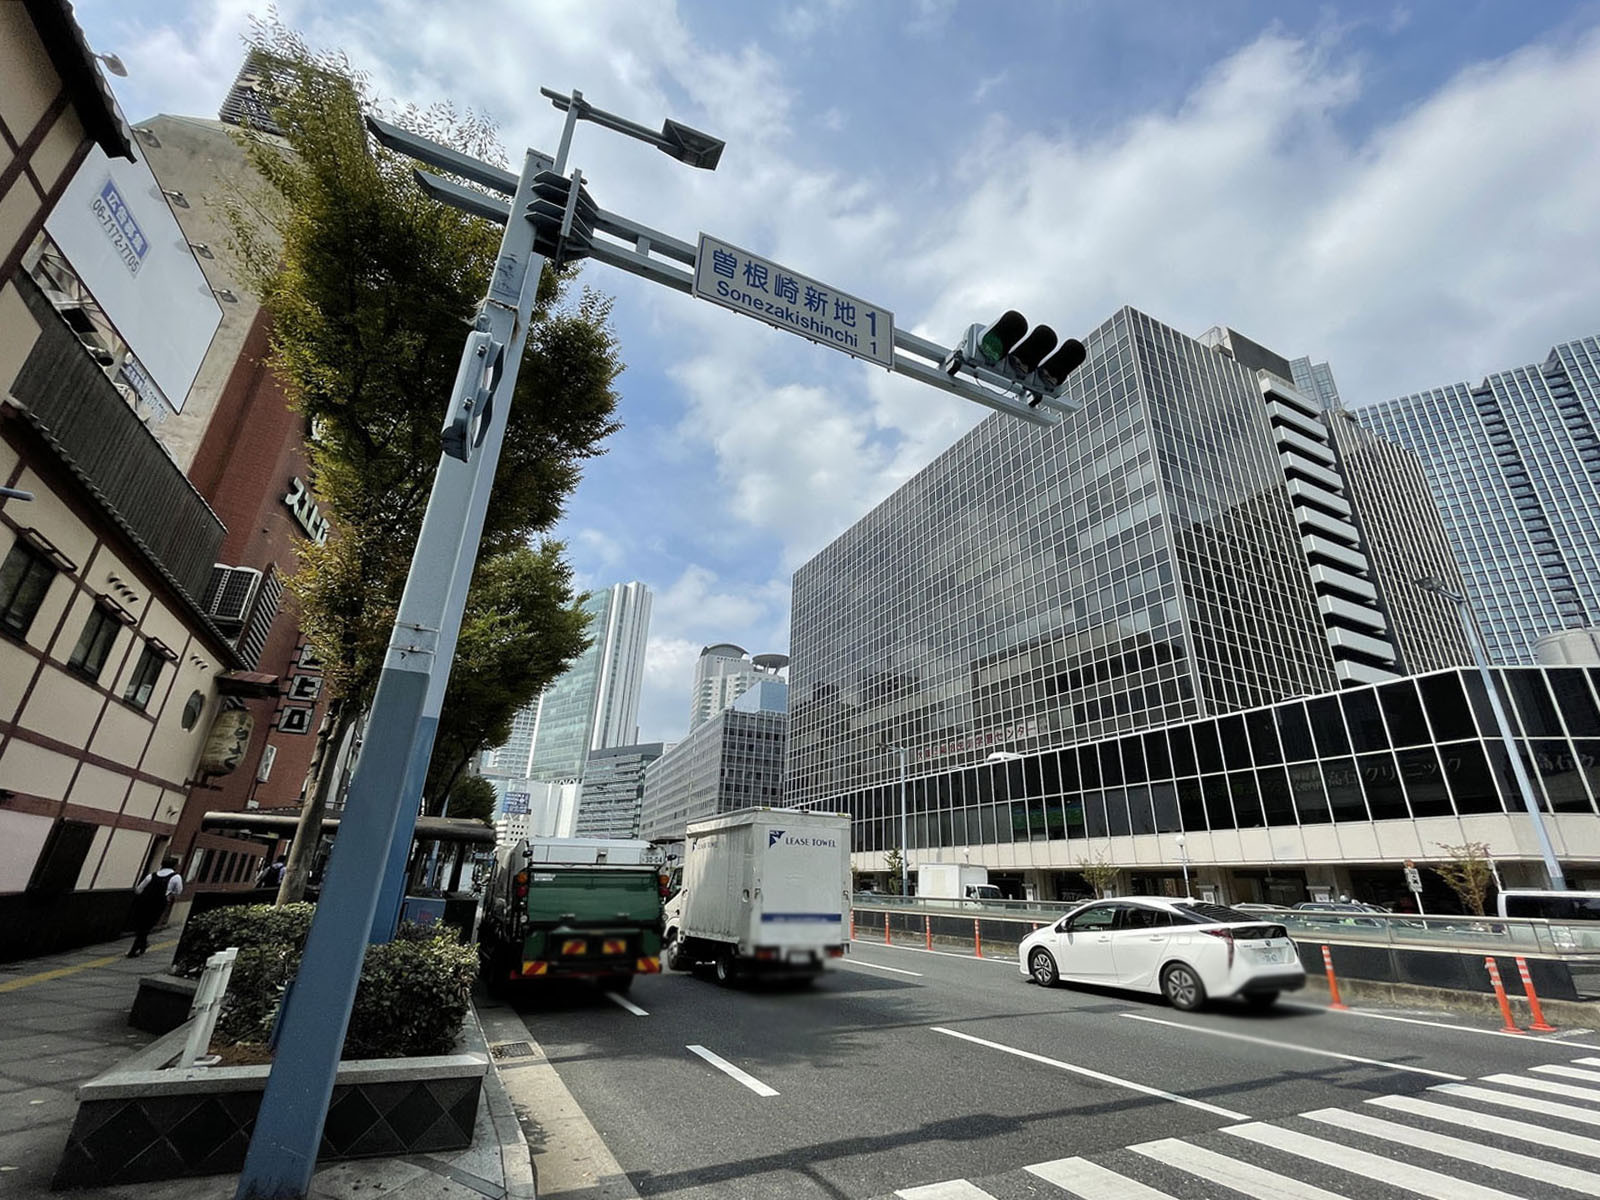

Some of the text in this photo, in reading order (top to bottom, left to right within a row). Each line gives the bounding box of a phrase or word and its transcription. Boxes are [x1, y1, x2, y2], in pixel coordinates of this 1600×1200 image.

[93, 199, 139, 272] 06-7172-7705
[717, 280, 877, 355] Sonezakishinchi 1
[785, 836, 836, 848] LEASE TOWEL
